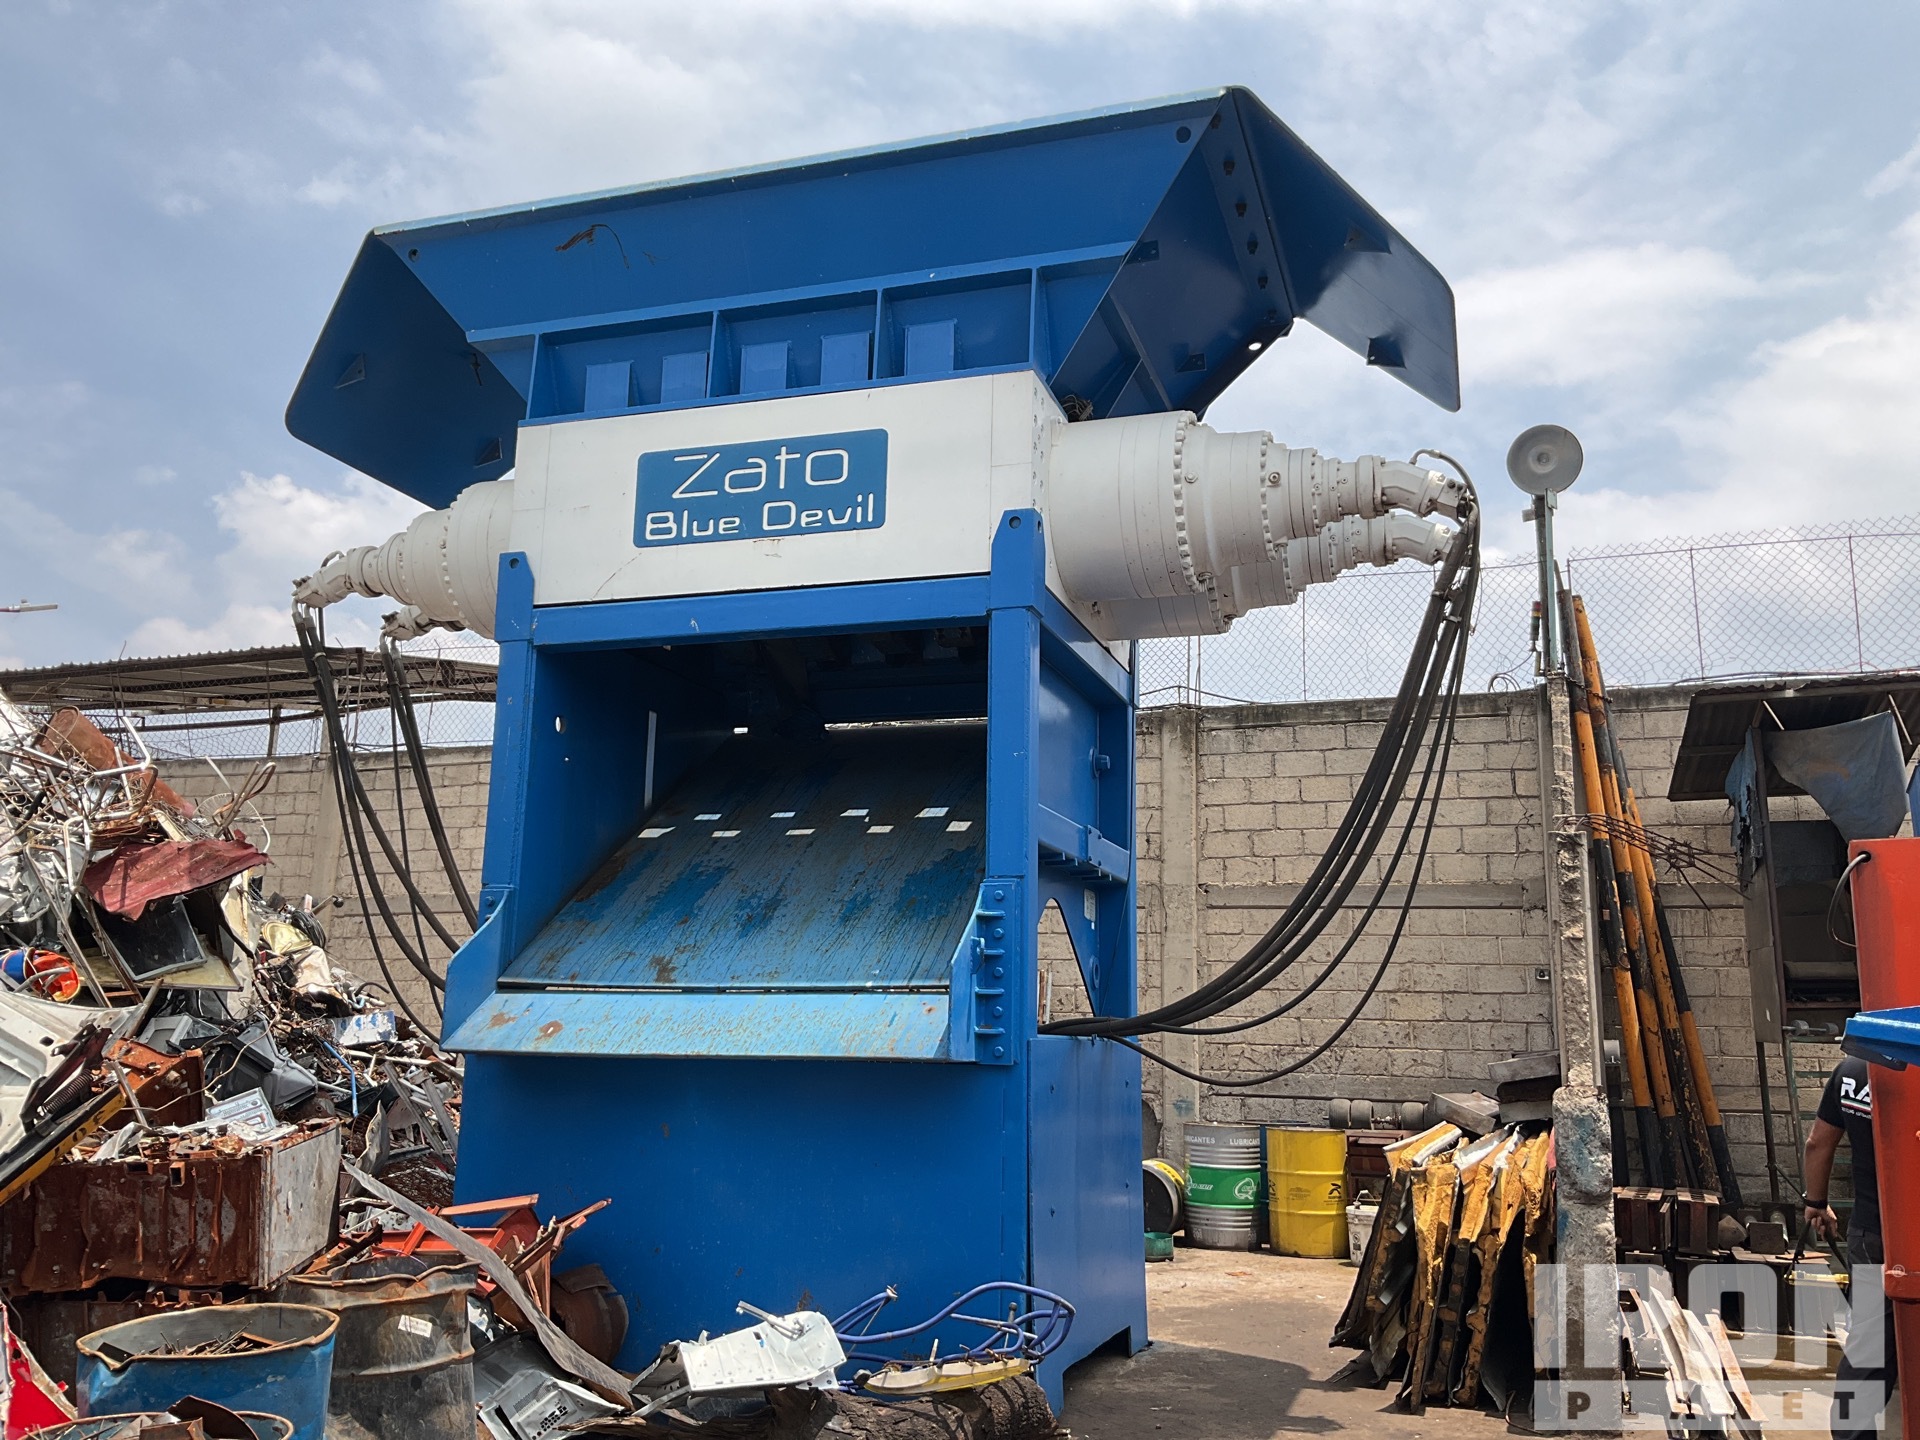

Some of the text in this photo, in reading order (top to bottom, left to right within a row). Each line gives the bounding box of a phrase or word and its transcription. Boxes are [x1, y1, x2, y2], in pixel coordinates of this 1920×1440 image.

[671, 445, 849, 498] Zato
[645, 492, 874, 541] Blue Devil
